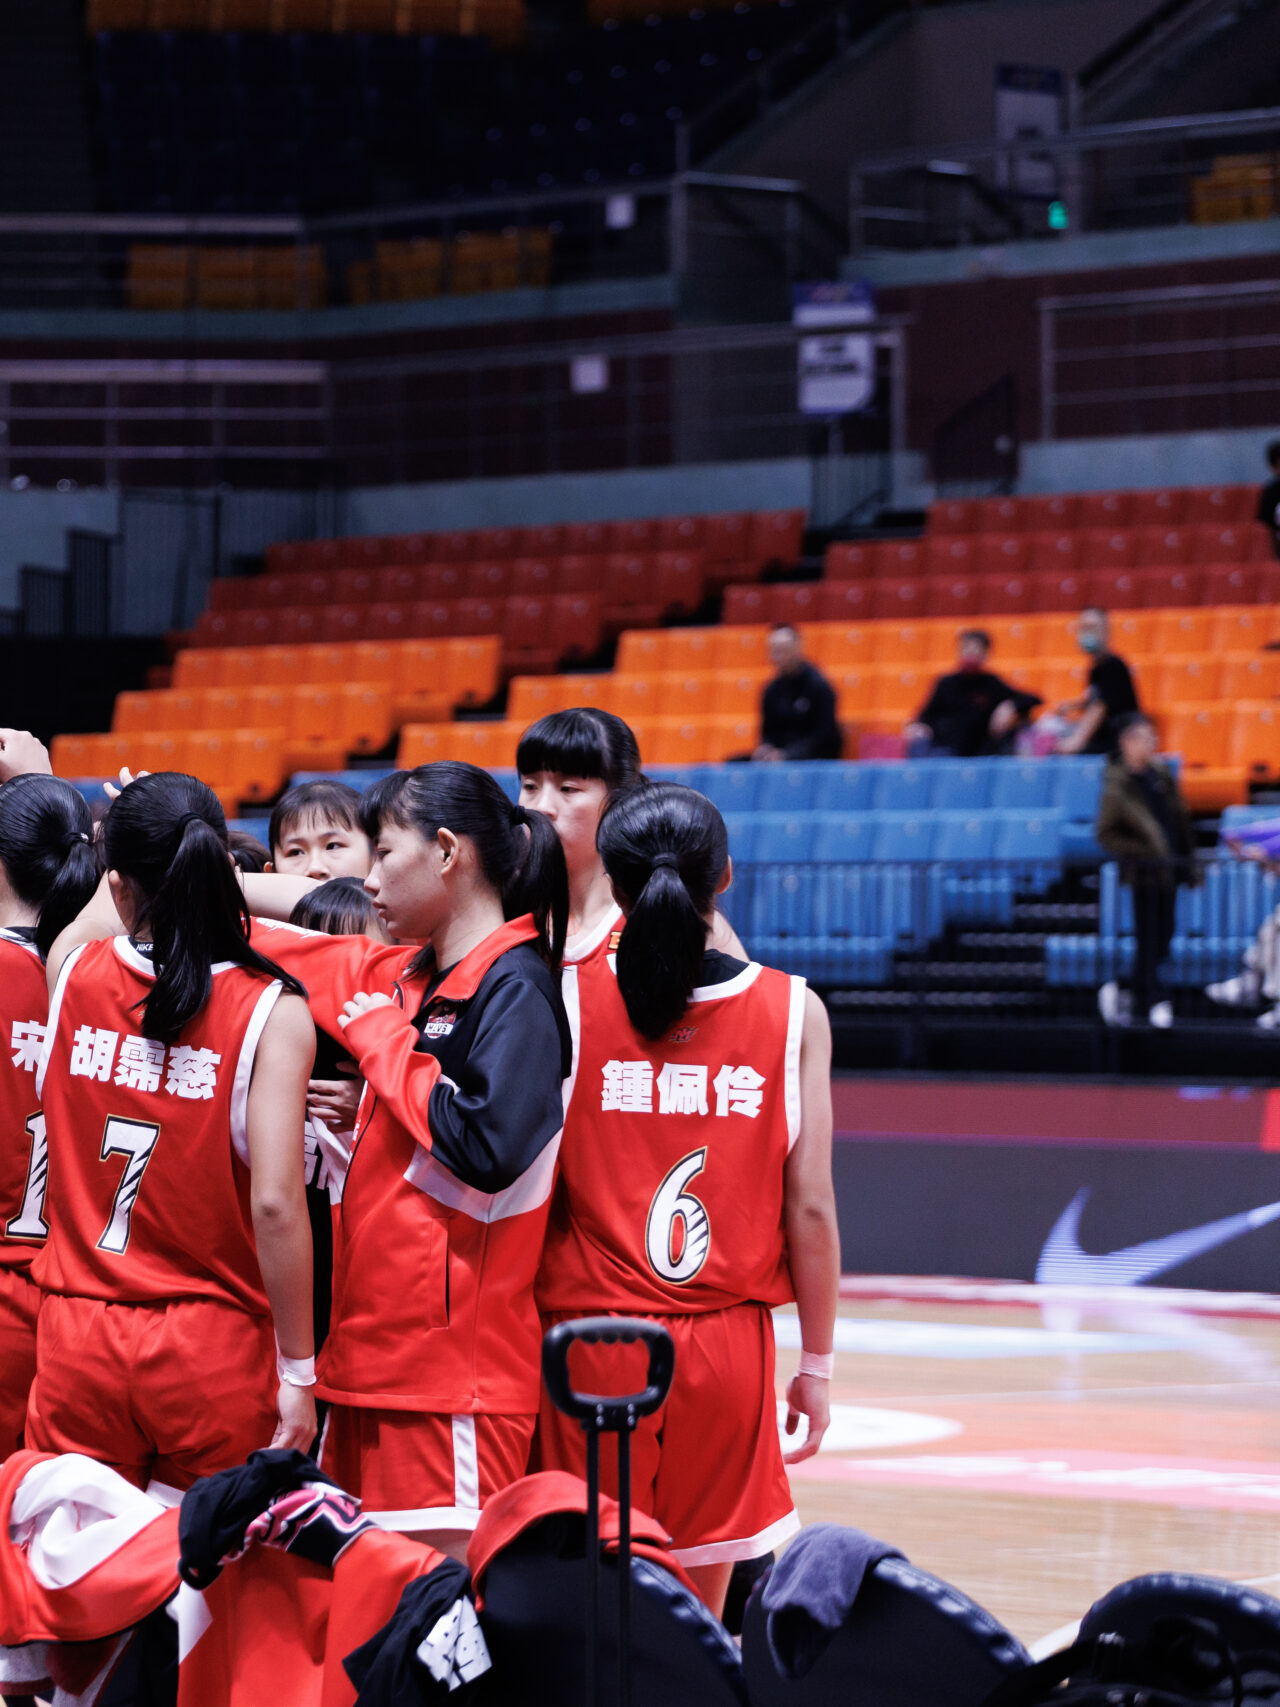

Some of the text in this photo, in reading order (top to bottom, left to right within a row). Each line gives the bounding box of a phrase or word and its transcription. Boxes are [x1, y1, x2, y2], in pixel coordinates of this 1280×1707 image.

[70, 1025, 222, 1100] 胡霈慈
[601, 1060, 767, 1119] 鍾佩伶
[95, 1113, 161, 1256] 7
[645, 1145, 711, 1285] 6
